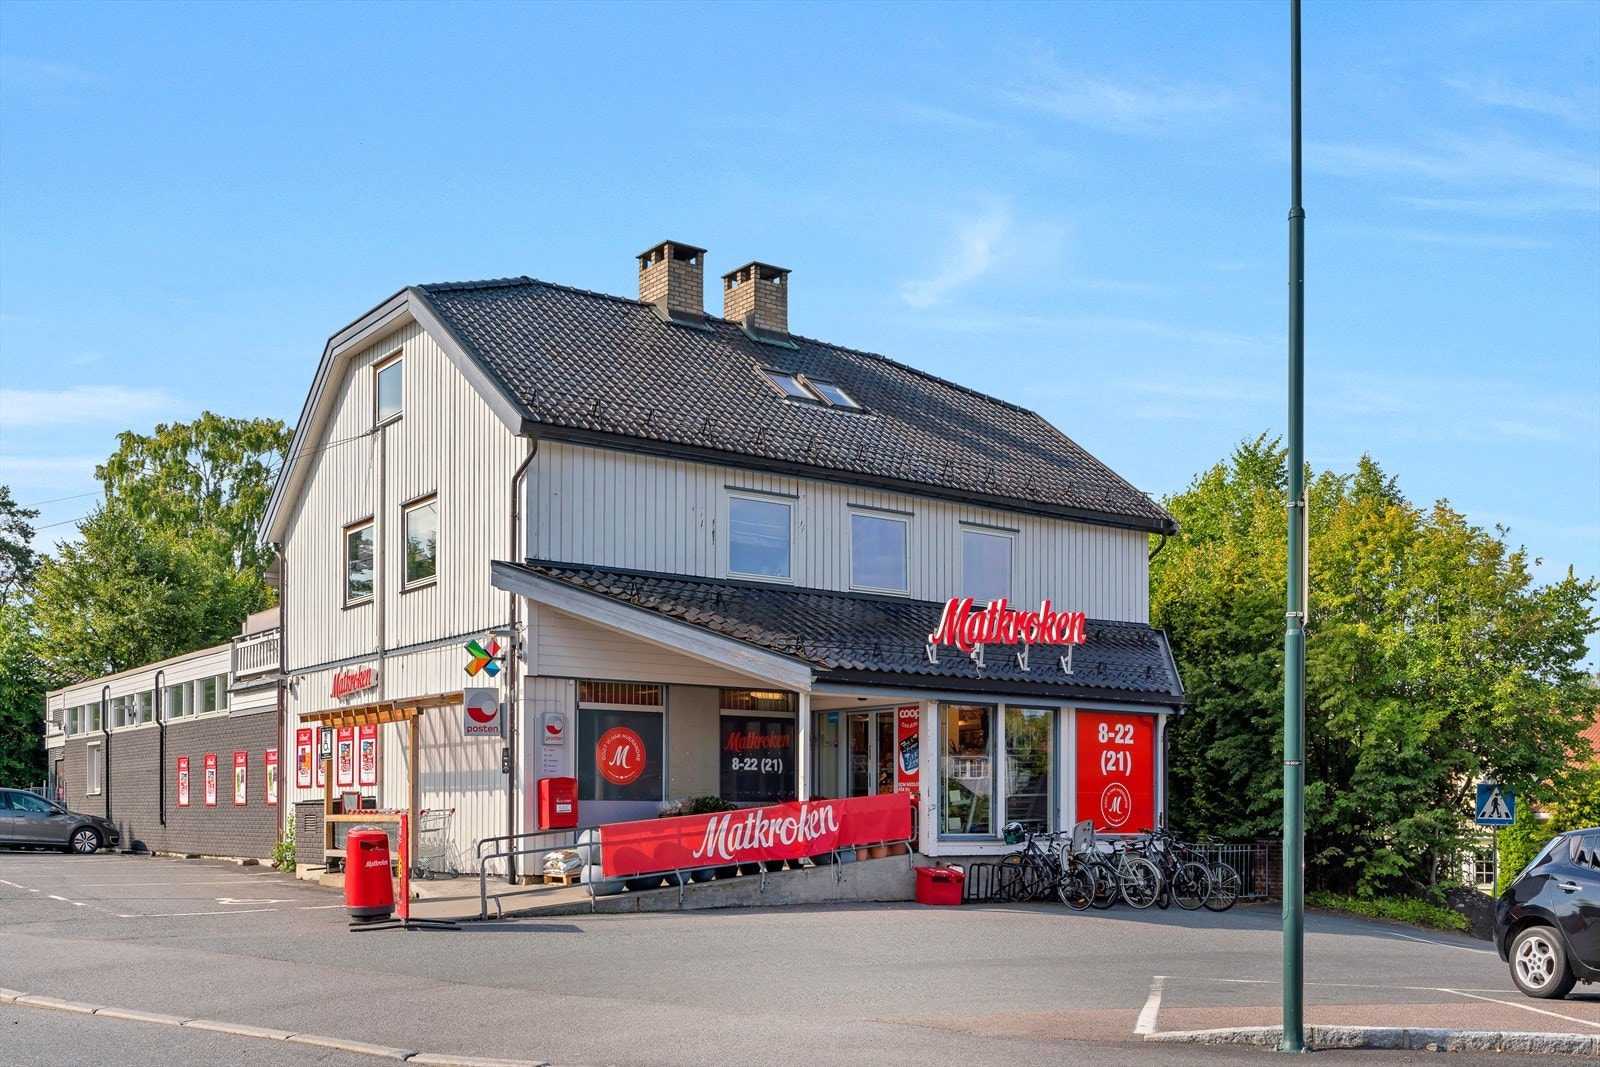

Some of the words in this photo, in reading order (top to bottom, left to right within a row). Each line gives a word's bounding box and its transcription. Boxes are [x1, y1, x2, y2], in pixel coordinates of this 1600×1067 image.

[929, 598, 1088, 652] Matkroken
[330, 665, 372, 699] Matkroken
[466, 725, 499, 733] posten
[1098, 722, 1134, 745] 8-22
[724, 730, 791, 753] Matkroken
[609, 745, 632, 769] M
[731, 757, 758, 771] 8-22
[760, 758, 783, 774] (21)
[1100, 750, 1132, 776] (21)
[1108, 796, 1123, 814] M
[692, 804, 839, 860] Matkroken
